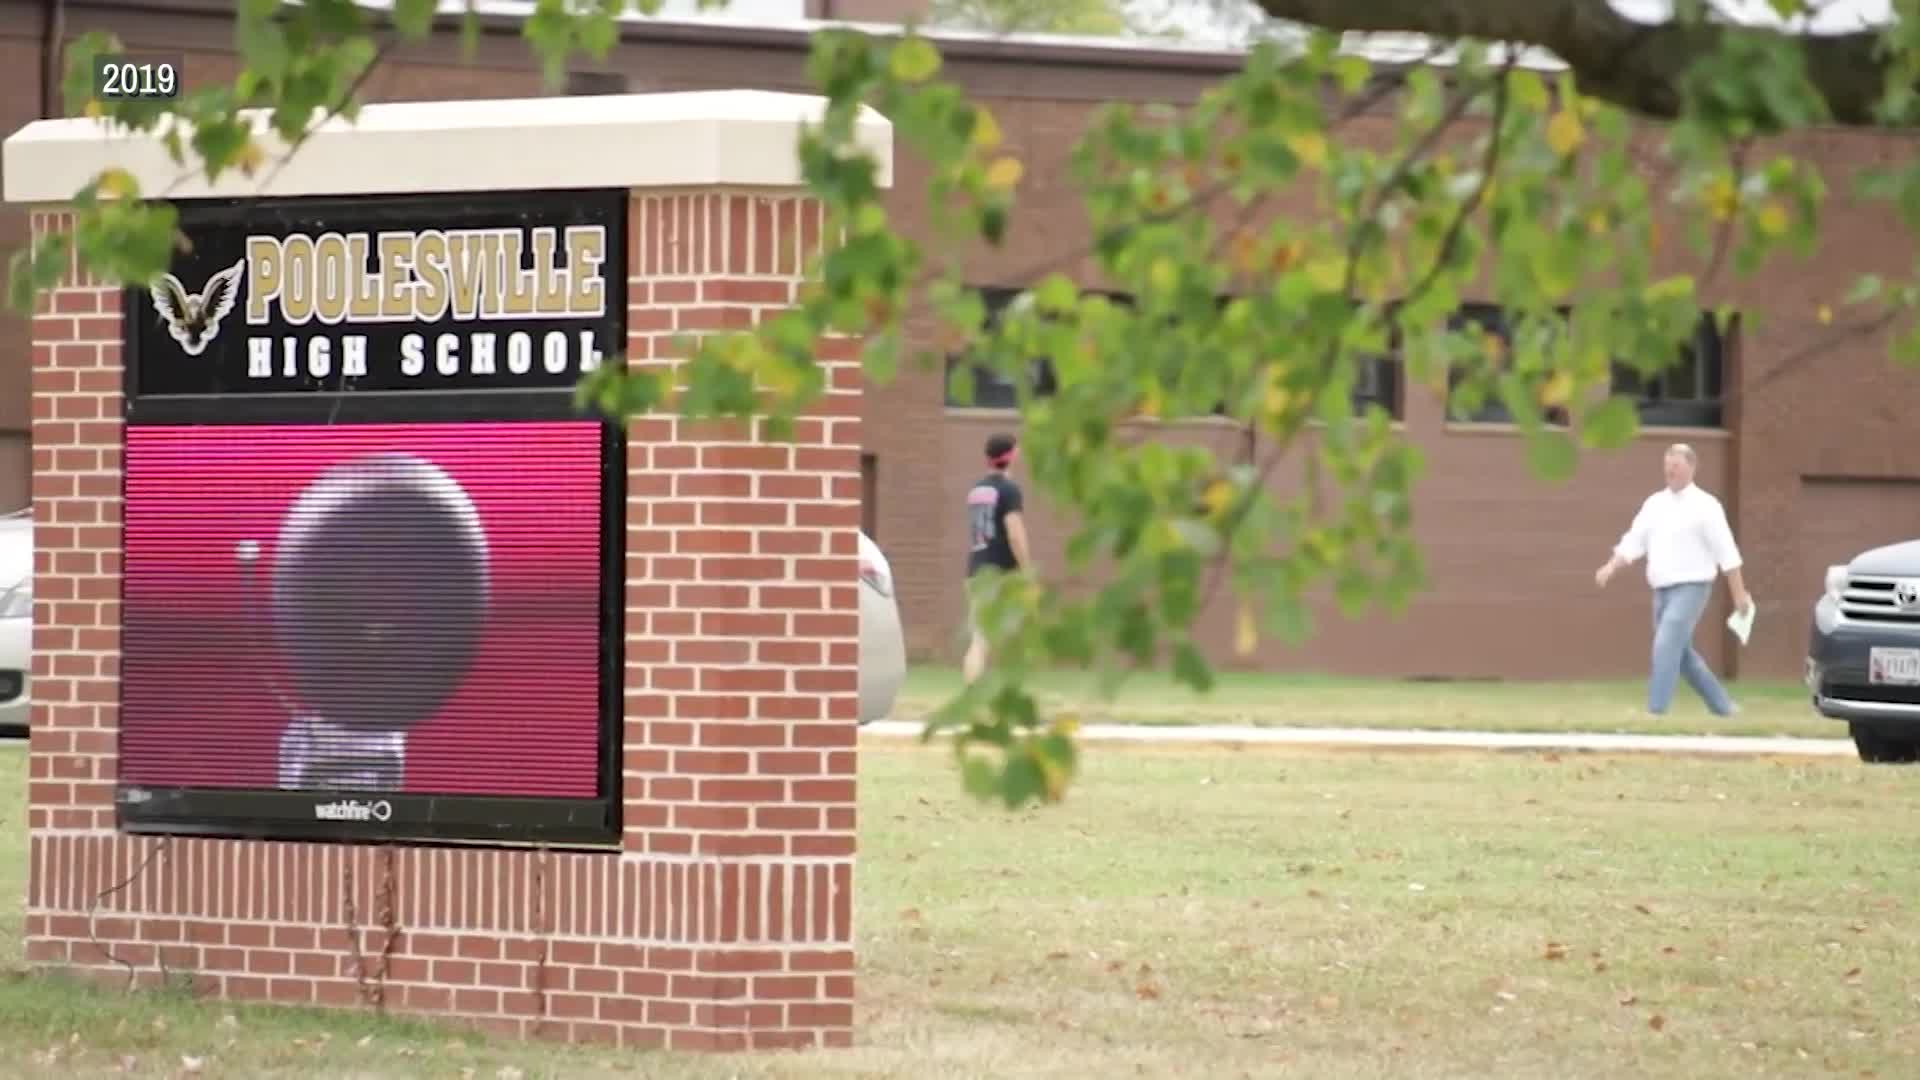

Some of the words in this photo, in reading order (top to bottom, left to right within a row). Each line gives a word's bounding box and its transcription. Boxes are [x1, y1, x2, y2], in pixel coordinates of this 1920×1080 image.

[246, 225, 606, 326] POOLESVILLE
[247, 335, 368, 378] HIGH
[400, 330, 603, 377] SCHOOL
